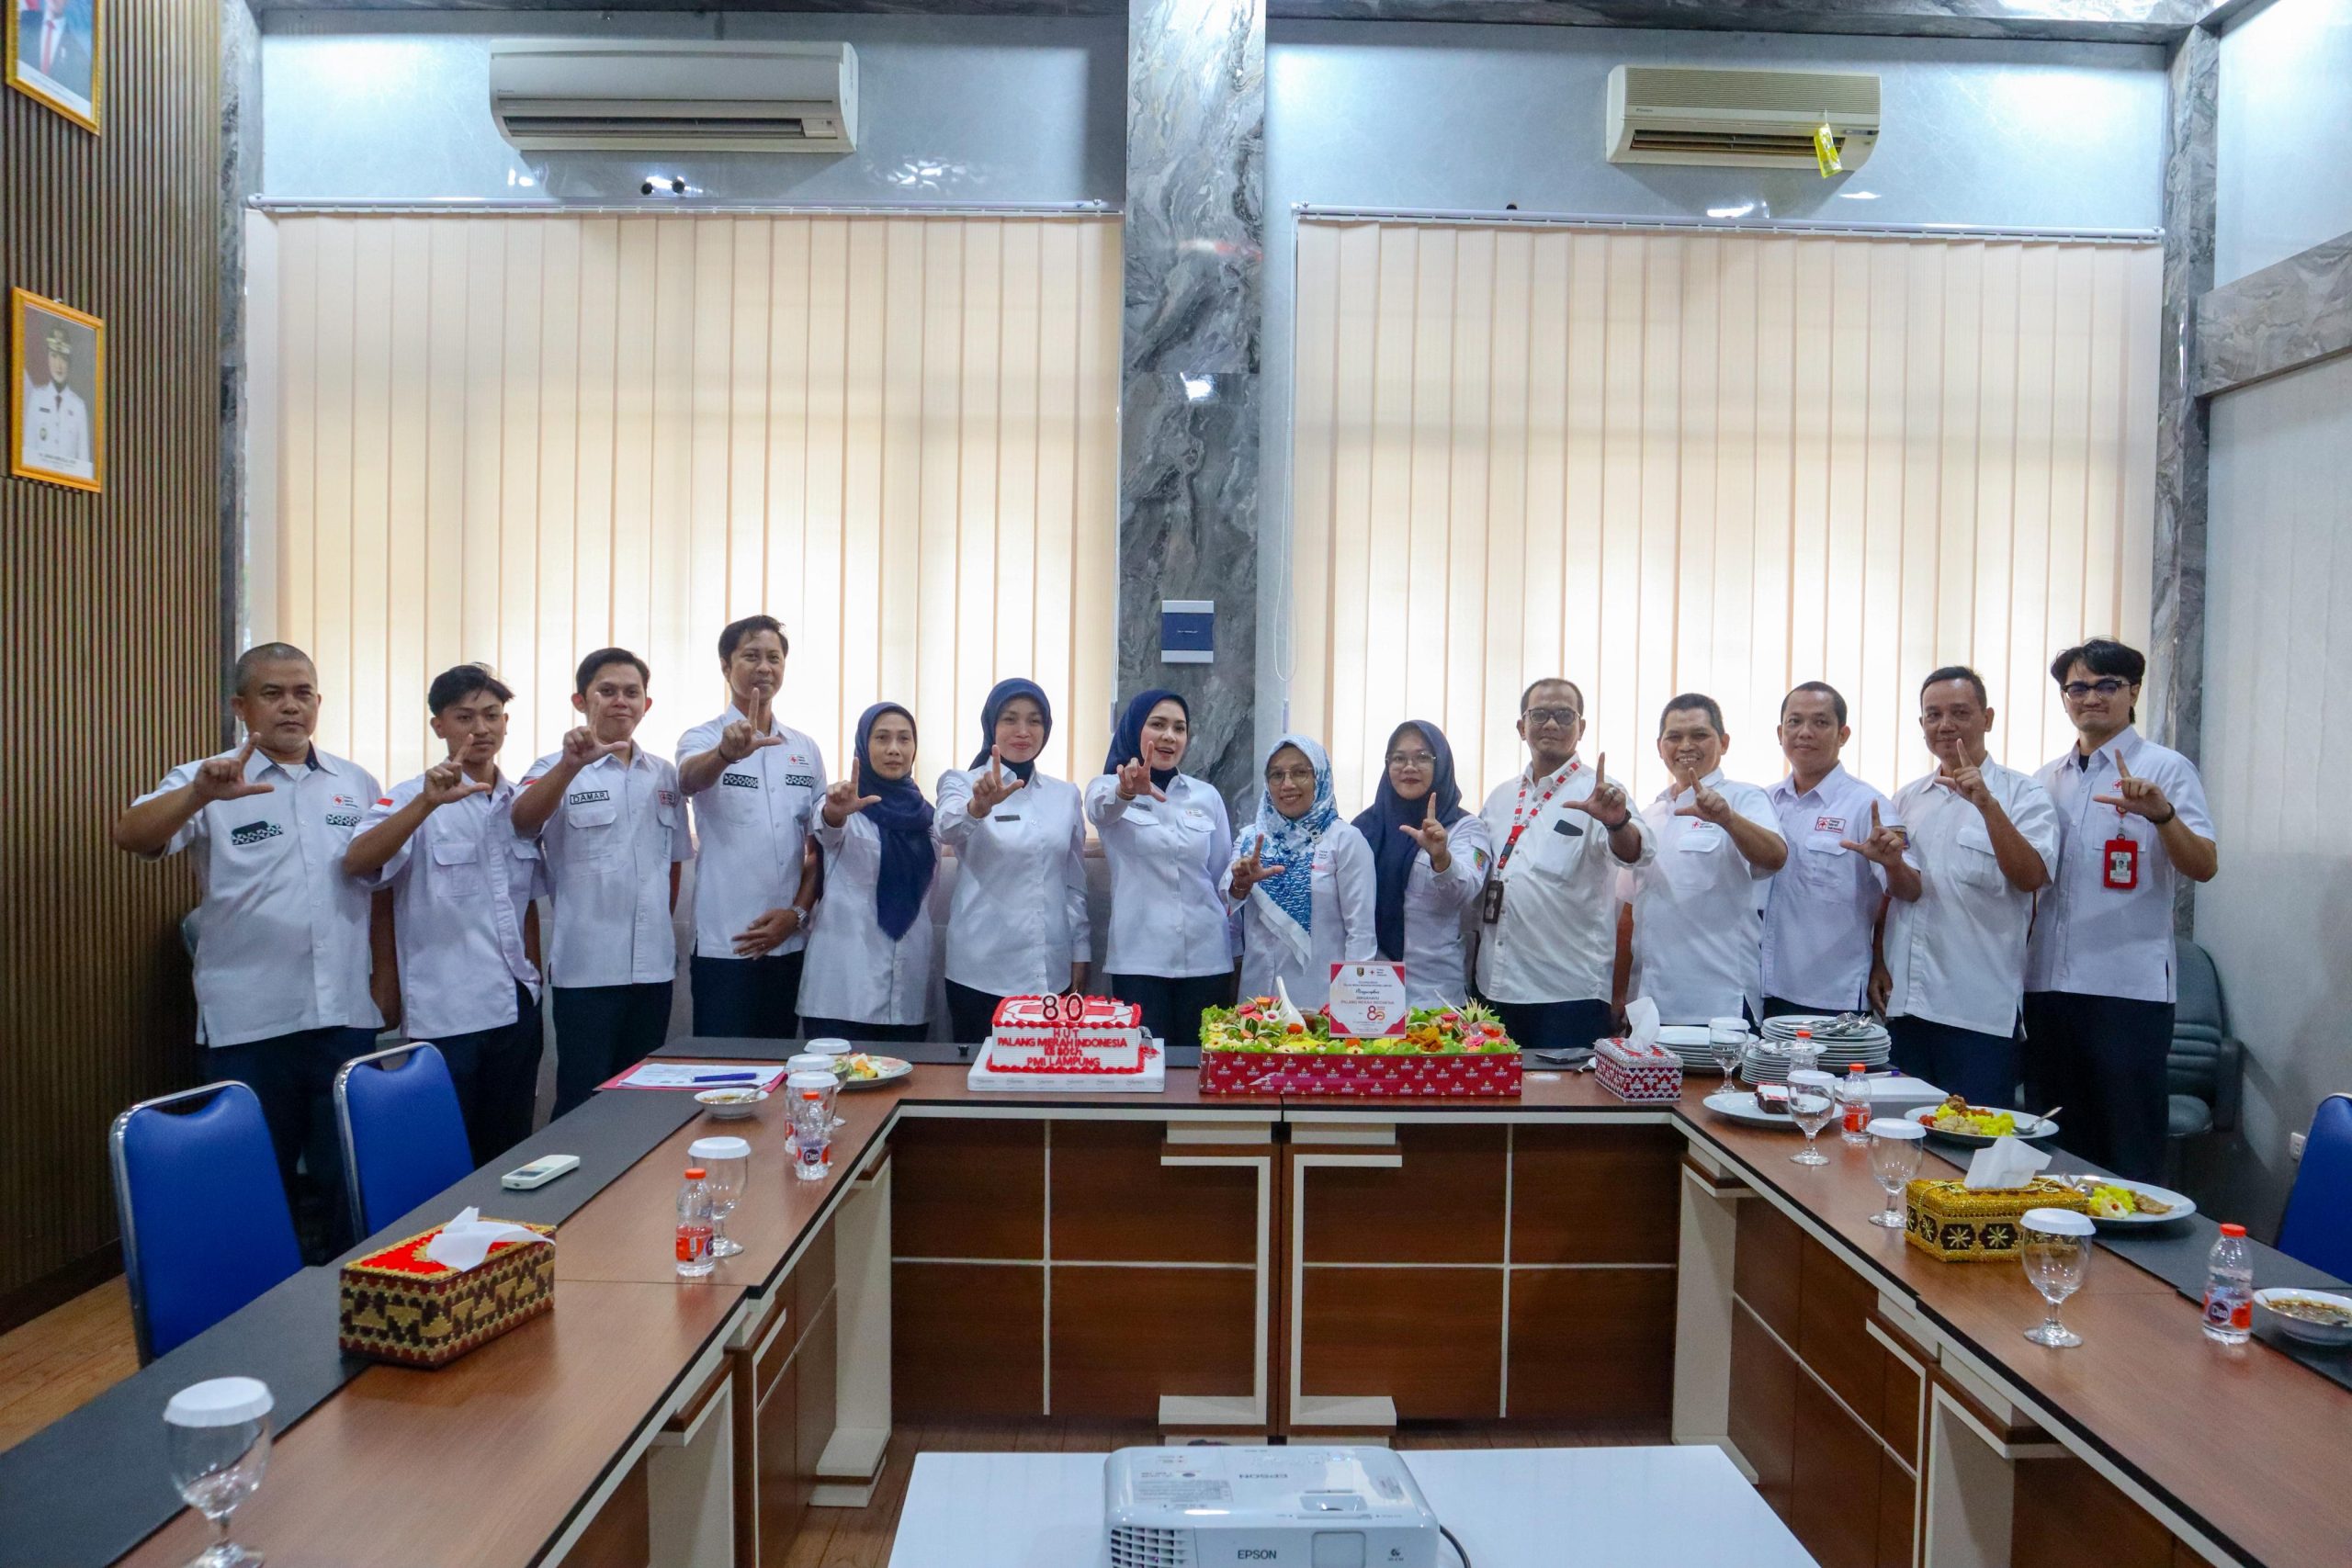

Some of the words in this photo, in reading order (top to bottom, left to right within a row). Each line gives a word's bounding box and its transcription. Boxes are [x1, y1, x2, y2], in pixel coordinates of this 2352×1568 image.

[572, 792, 605, 803] DAMAR
[1042, 993, 1084, 1021] 80
[1053, 1029, 1079, 1038] HUT
[997, 1037, 1035, 1047] PALANG
[1037, 1037, 1073, 1047] MERAH
[1075, 1037, 1127, 1047] INDONESIA
[1027, 1056, 1046, 1066] PMI
[1049, 1056, 1101, 1066] LAMPUNG
[1238, 1550, 1277, 1560] EPSON
